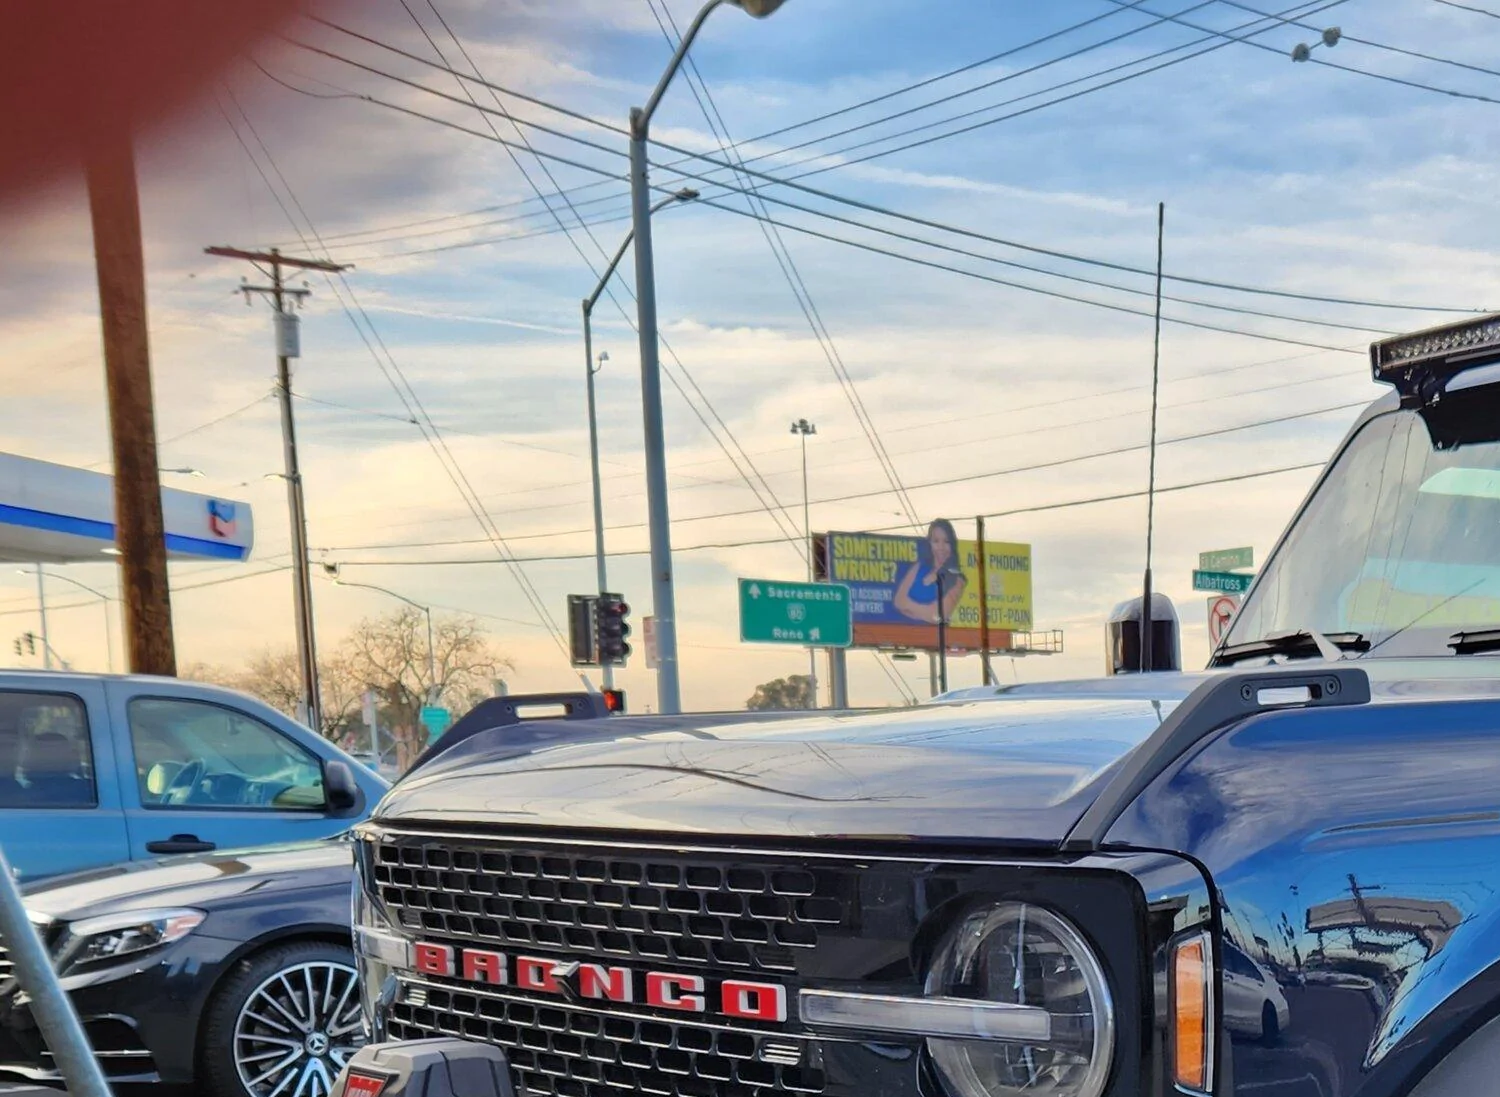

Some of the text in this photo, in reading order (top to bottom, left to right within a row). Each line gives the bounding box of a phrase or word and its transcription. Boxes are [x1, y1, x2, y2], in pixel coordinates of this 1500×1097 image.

[833, 536, 918, 563] SOMETHING
[834, 559, 897, 583] WRONG?
[1195, 573, 1241, 590] Albatross
[767, 586, 842, 601] Sacramento
[772, 627, 804, 640] Reno
[415, 942, 788, 1023] BRONCO
